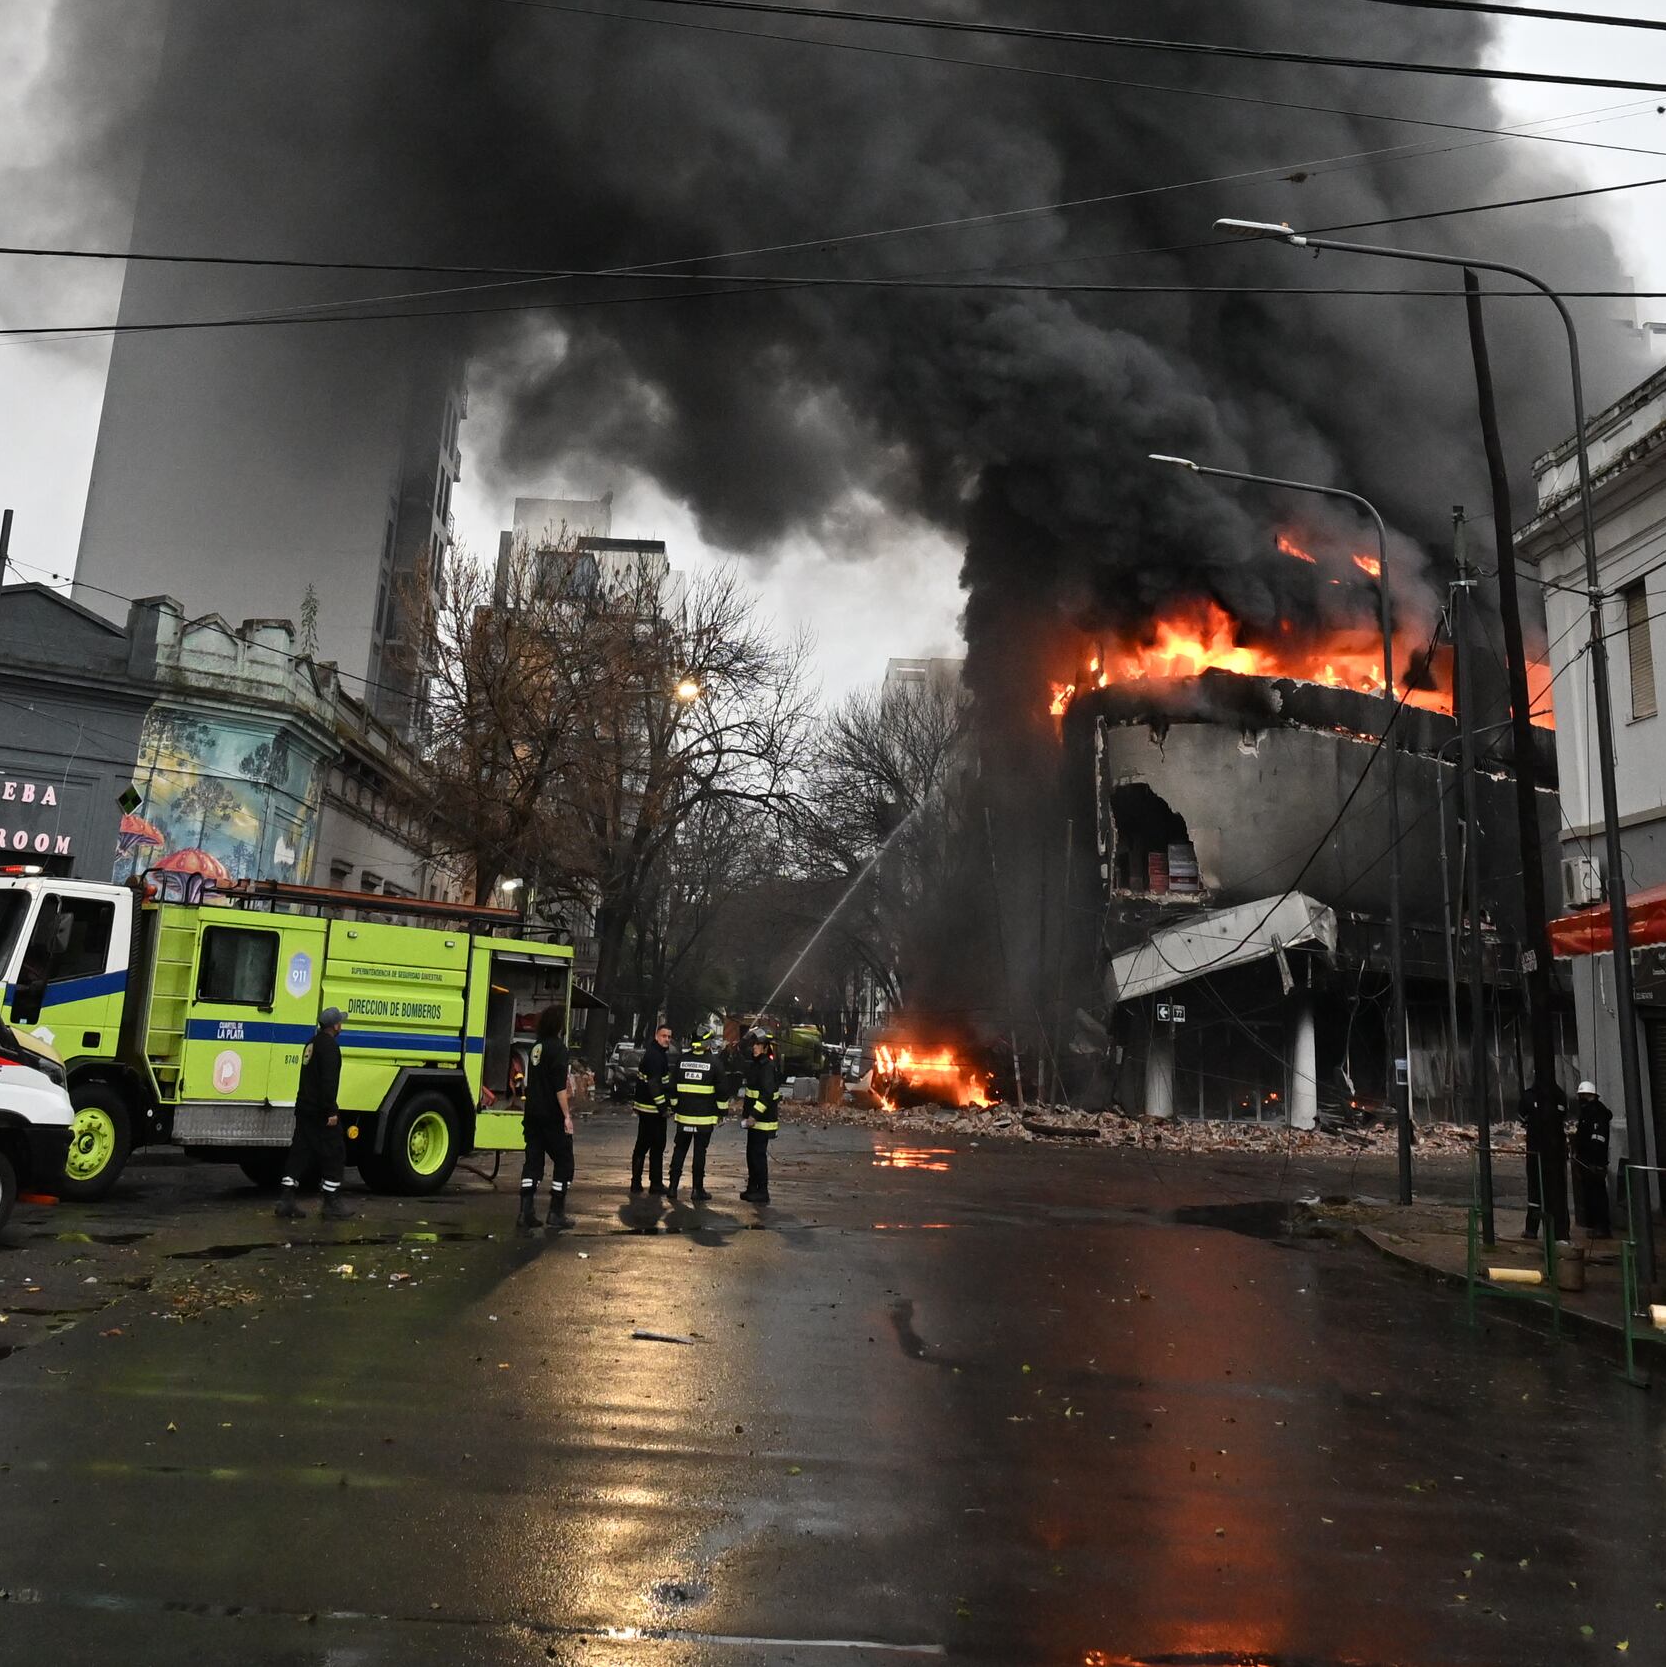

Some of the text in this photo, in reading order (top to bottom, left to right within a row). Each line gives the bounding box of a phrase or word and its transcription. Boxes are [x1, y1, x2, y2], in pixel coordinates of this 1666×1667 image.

[292, 970, 307, 983] 911
[348, 998, 442, 1020] DIRECCION DE BOMBEROS
[219, 1021, 236, 1029] CUARTEL
[217, 1029, 244, 1040] LA PLATA
[284, 1055, 299, 1065] 8740
[681, 1062, 710, 1070] BOMBEROS
